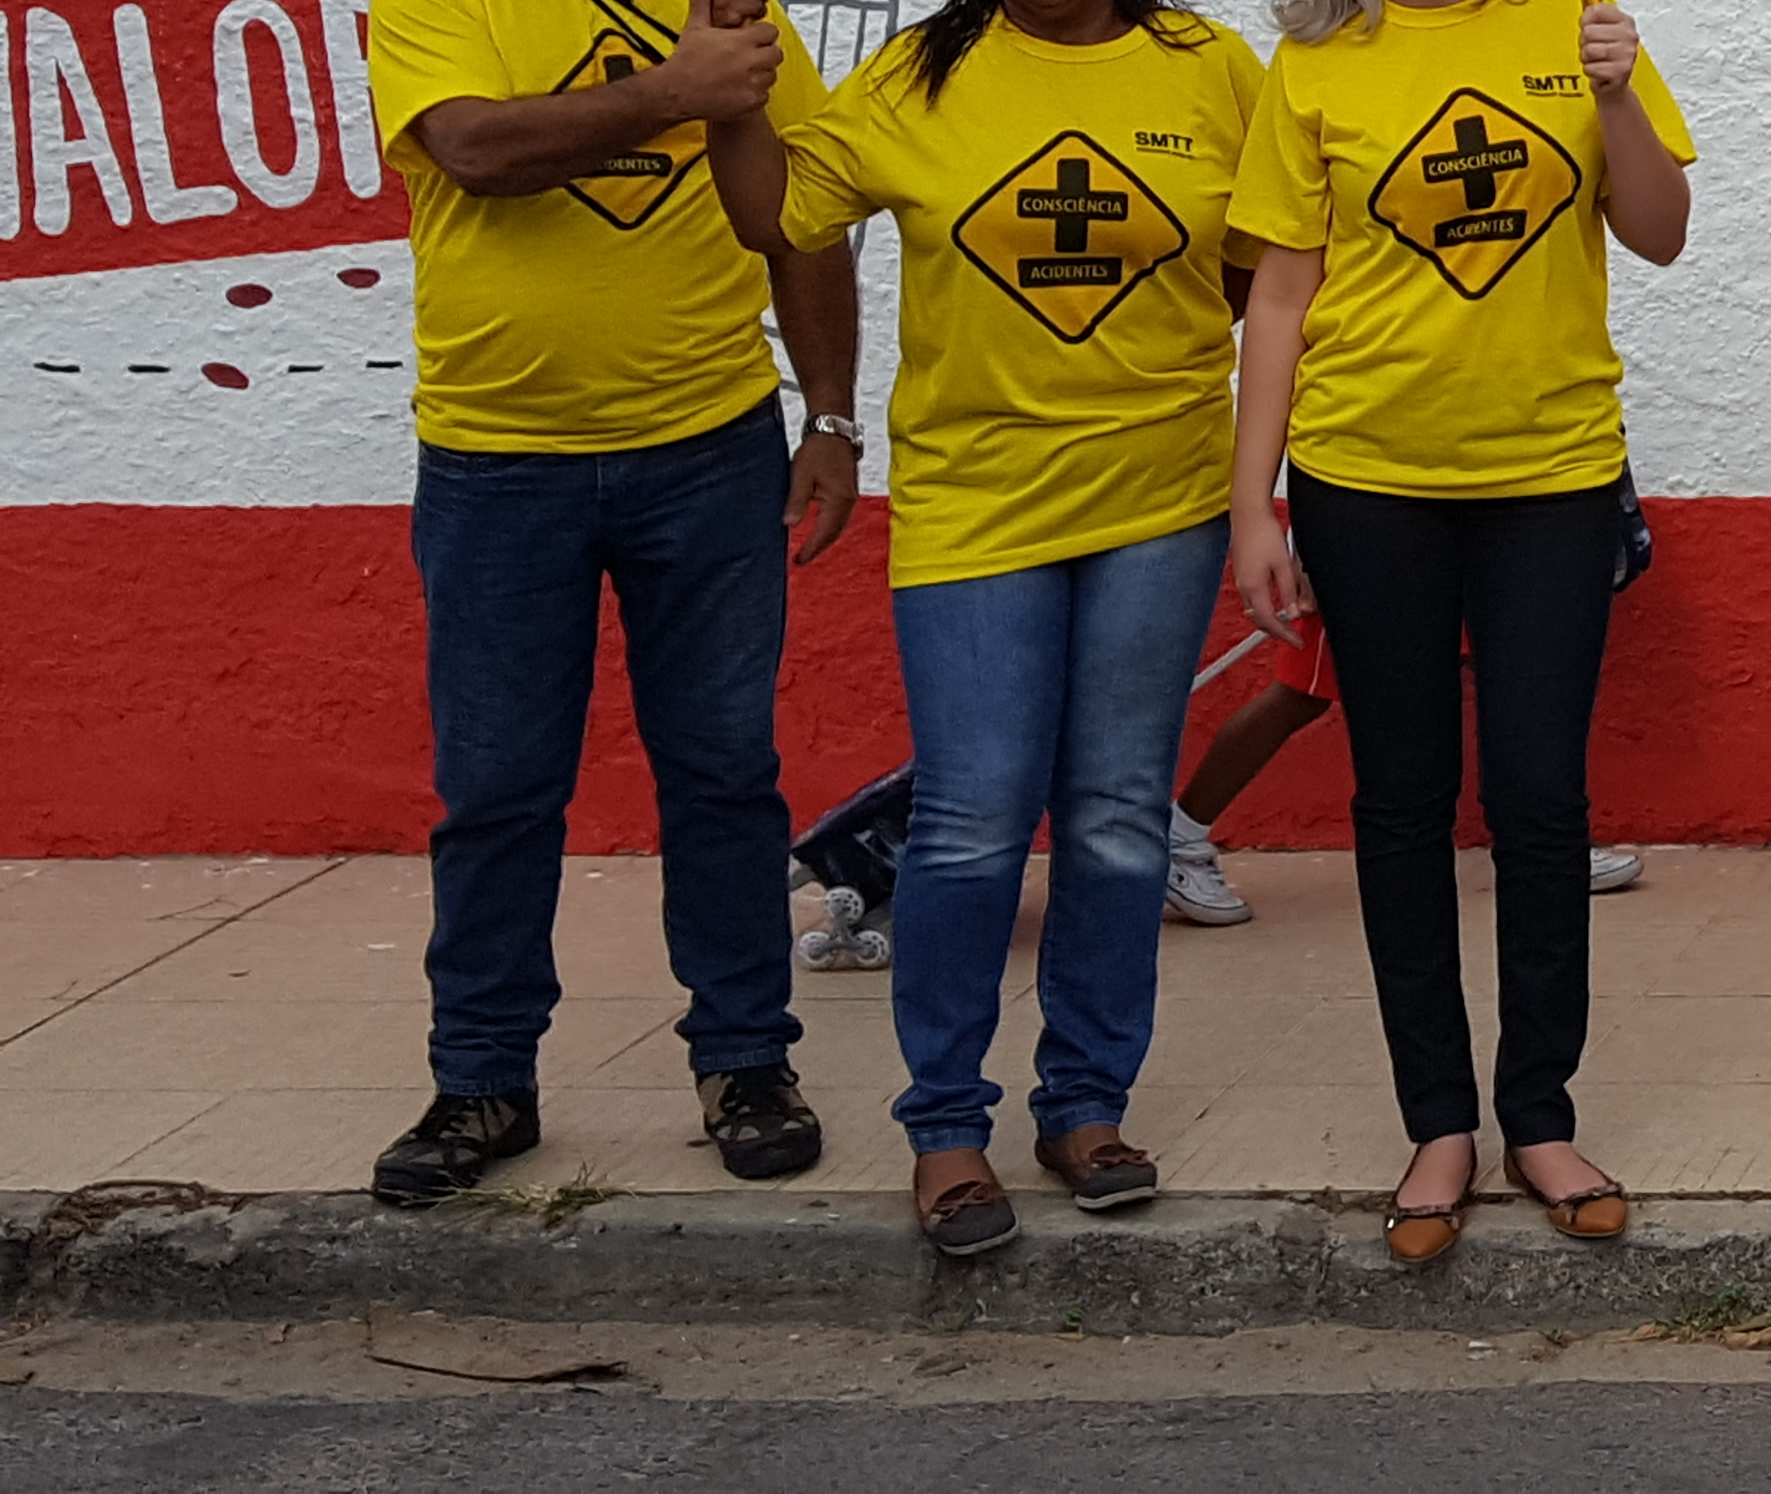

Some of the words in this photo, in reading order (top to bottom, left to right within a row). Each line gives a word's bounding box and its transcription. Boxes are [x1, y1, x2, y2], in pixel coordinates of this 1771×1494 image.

[1523, 75, 1580, 90] SMTT
[1135, 132, 1193, 151] SMTT
[1428, 148, 1523, 176] CONSCIÊNCIA
[1022, 197, 1123, 214] CONSCIÊNCIA
[1447, 217, 1514, 239] ACIDENTES
[1031, 266, 1108, 279] ACIDENTES
